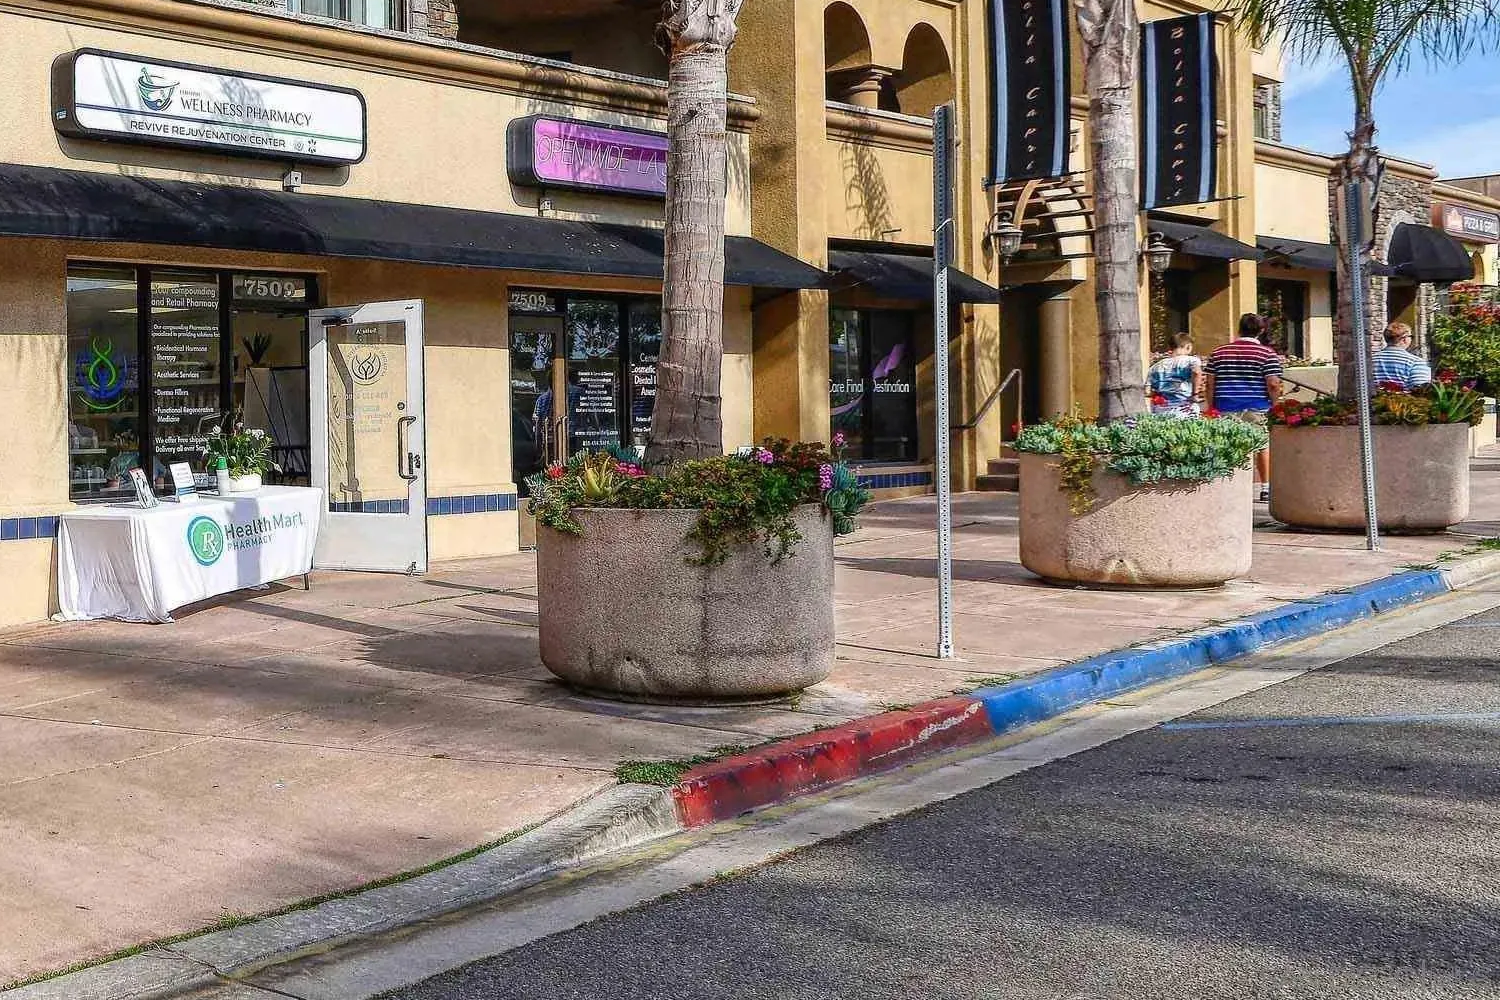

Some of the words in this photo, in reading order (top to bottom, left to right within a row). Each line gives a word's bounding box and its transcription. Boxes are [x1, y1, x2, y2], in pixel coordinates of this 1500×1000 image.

[1170, 27, 1186, 103] Bella
[181, 97, 243, 118] WELLNESS
[246, 106, 312, 127] PHARMACY
[130, 121, 170, 134] REVIVE
[172, 125, 247, 143] REJUVENATION
[250, 135, 286, 148] CENTER
[1024, 87, 1040, 170] Capri
[538, 135, 587, 168] OPEN
[589, 144, 628, 172] WIDE
[1171, 123, 1188, 197] Capri
[171, 285, 216, 297] compounding
[244, 279, 296, 298] 7509
[151, 298, 165, 306] and
[167, 298, 185, 306] Retail
[187, 299, 219, 309] Pharmacy
[512, 294, 546, 307] 7509
[156, 353, 177, 362] Therapy
[634, 375, 653, 384] Dental
[845, 379, 864, 393] Final
[155, 446, 176, 454] Delivery
[225, 516, 271, 540] Health
[272, 511, 304, 530] Mart
[227, 534, 273, 551] PHARMACY
